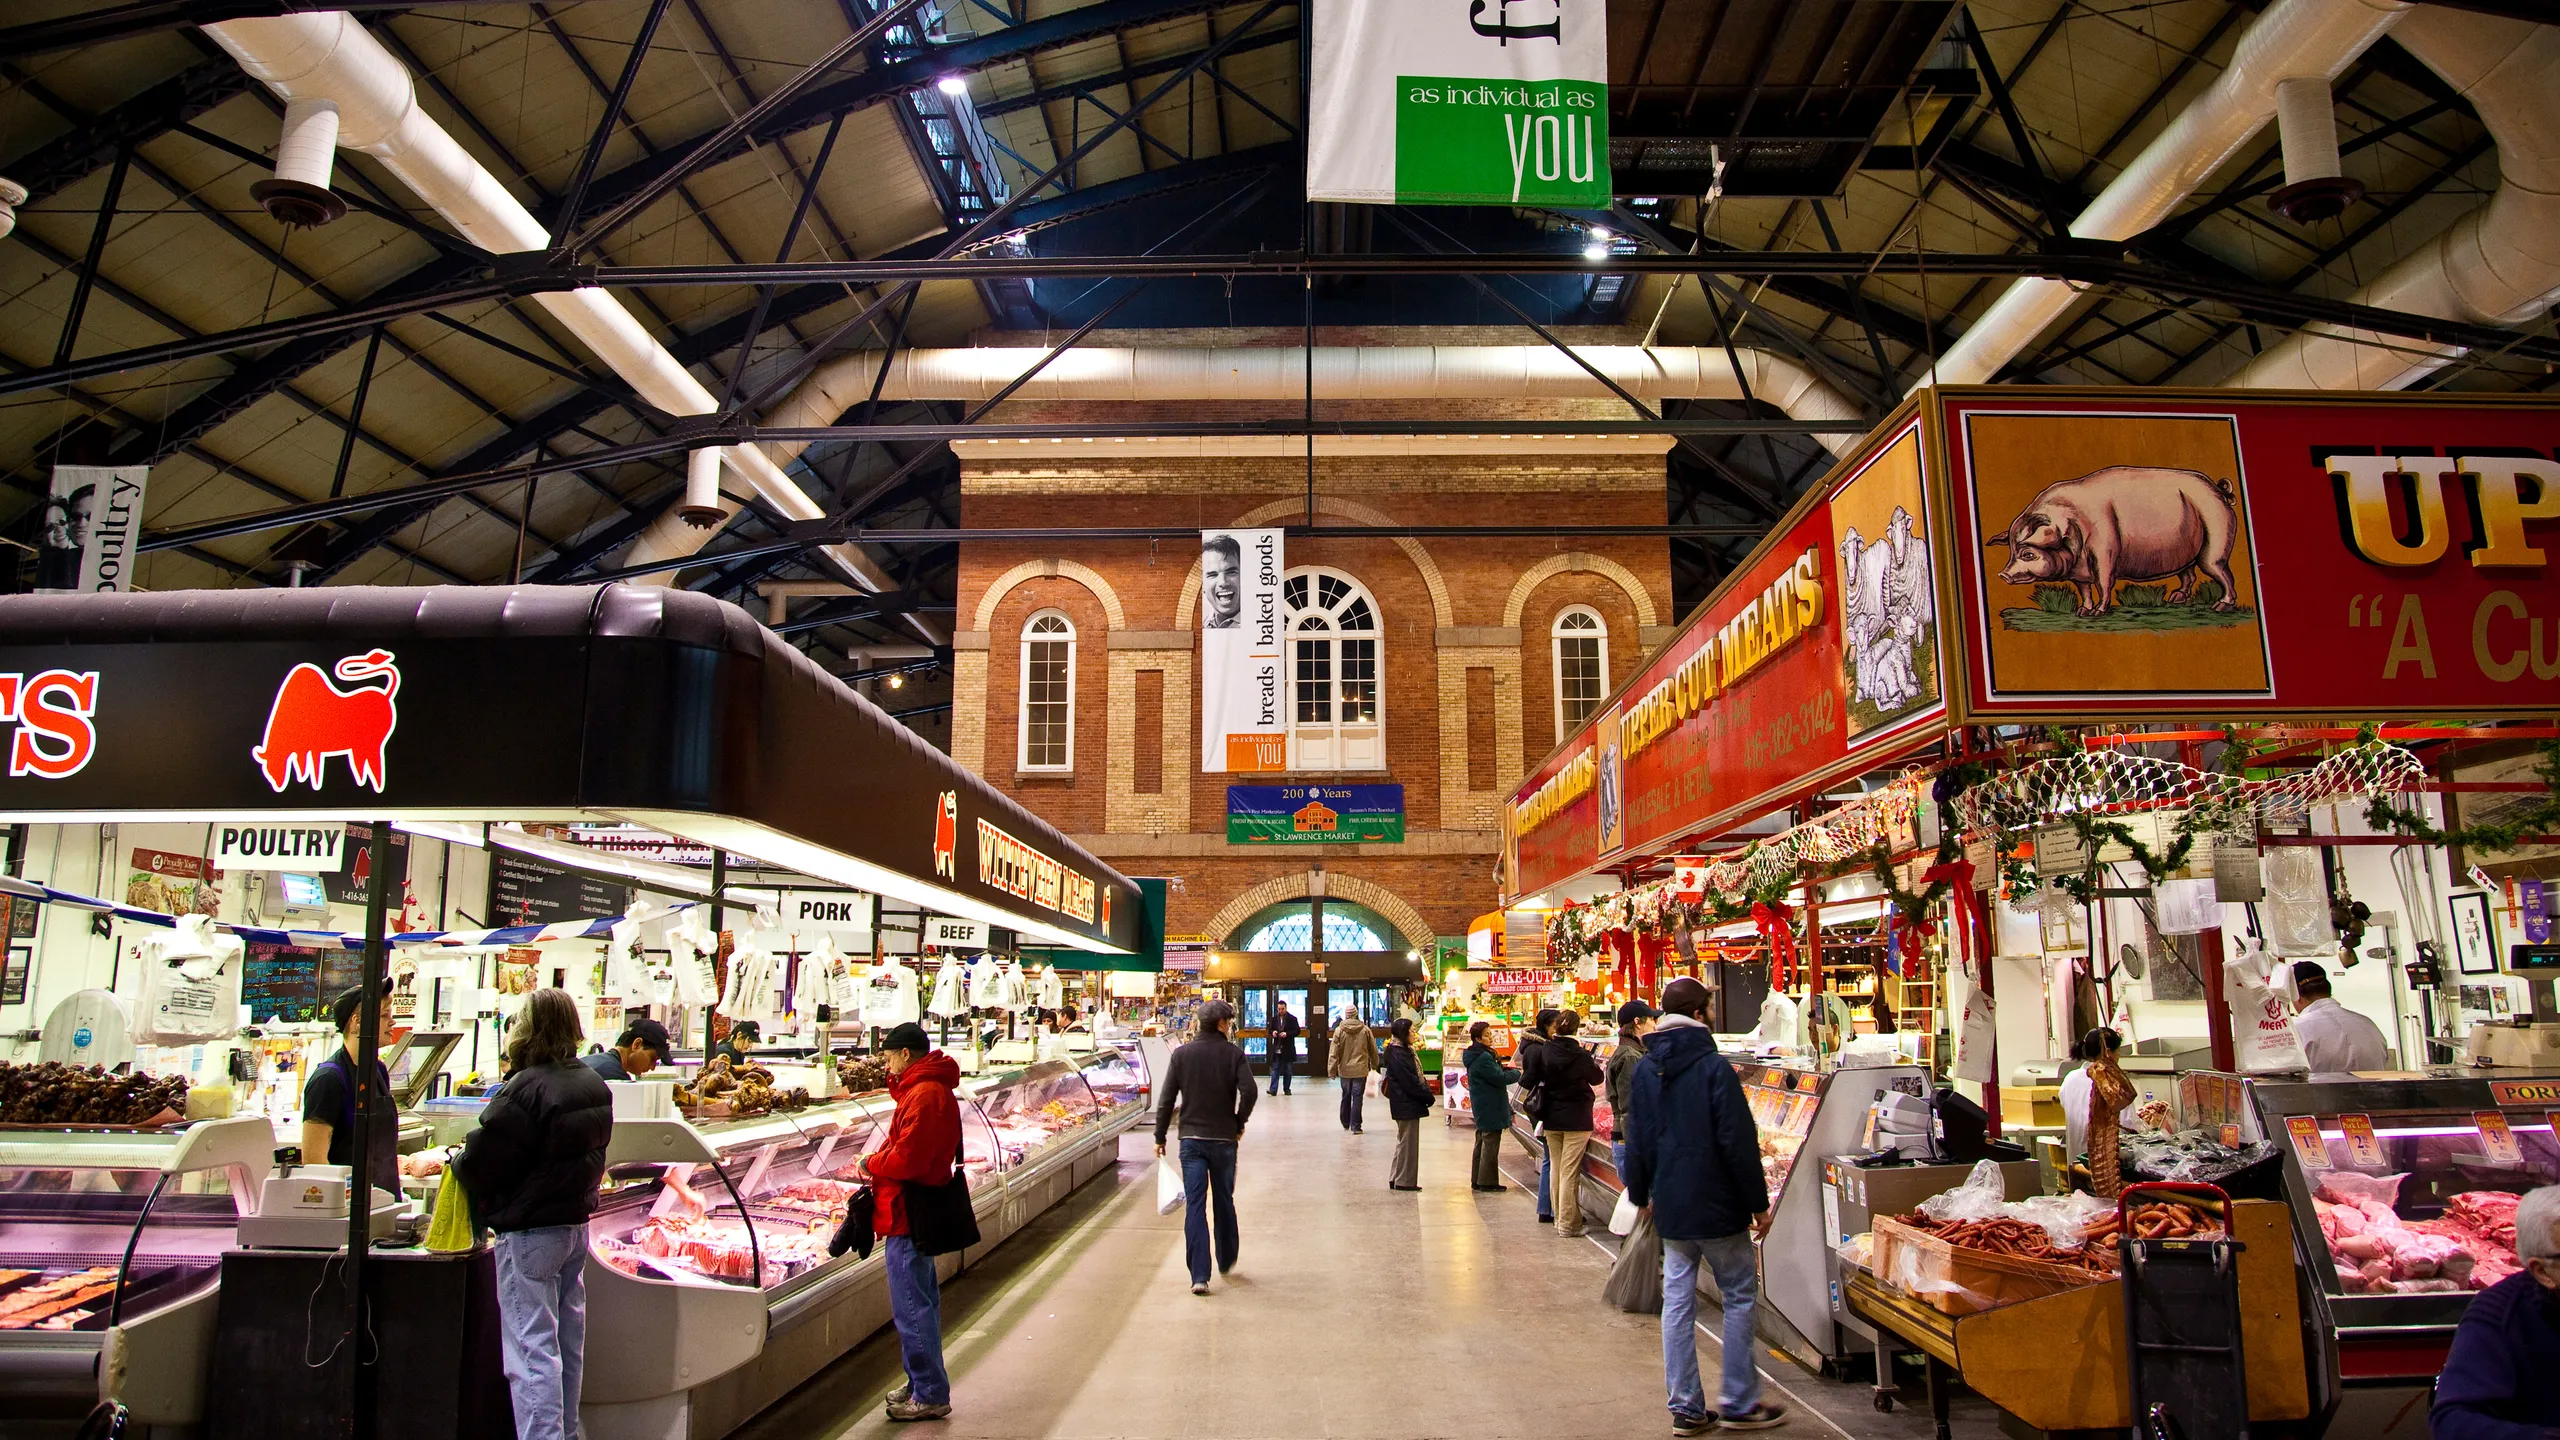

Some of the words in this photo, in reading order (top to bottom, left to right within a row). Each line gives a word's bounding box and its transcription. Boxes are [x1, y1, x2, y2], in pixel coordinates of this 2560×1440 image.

[1410, 86, 1439, 104] as
[1446, 85, 1559, 108] individual
[1566, 90, 1595, 109] as
[1504, 113, 1594, 203] you
[1255, 534, 1279, 586] goods
[1255, 592, 1275, 646] baked
[1620, 677, 1678, 761] UPPER
[1675, 636, 1722, 721] CUT
[1718, 548, 1825, 690] MEATS
[1256, 665, 1275, 726] breads
[1240, 735, 1272, 743] individual
[1713, 711, 1729, 742] The
[1743, 688, 1836, 773] 416-362-3142
[1255, 743, 1282, 771] you
[1558, 744, 1597, 808] MEATS
[1282, 788, 1305, 799] 200
[1322, 787, 1352, 799] Years
[1627, 780, 1671, 830] WHOLESALE
[1673, 776, 1681, 809] &
[1683, 761, 1714, 805] RETAIL
[220, 828, 341, 858] POULTRY
[1323, 833, 1356, 841] MARKET
[977, 817, 1061, 912] WITTEVEEN
[1060, 865, 1096, 925] MEATS
[799, 901, 853, 922] PORK
[939, 924, 976, 940] BEEF
[1489, 969, 1552, 985] TAKE-OUT
[392, 998, 417, 1006] ANGUS
[396, 1006, 413, 1014] BEEF
[2293, 1120, 2310, 1129] Pork
[2343, 1122, 2357, 1130] Pork
